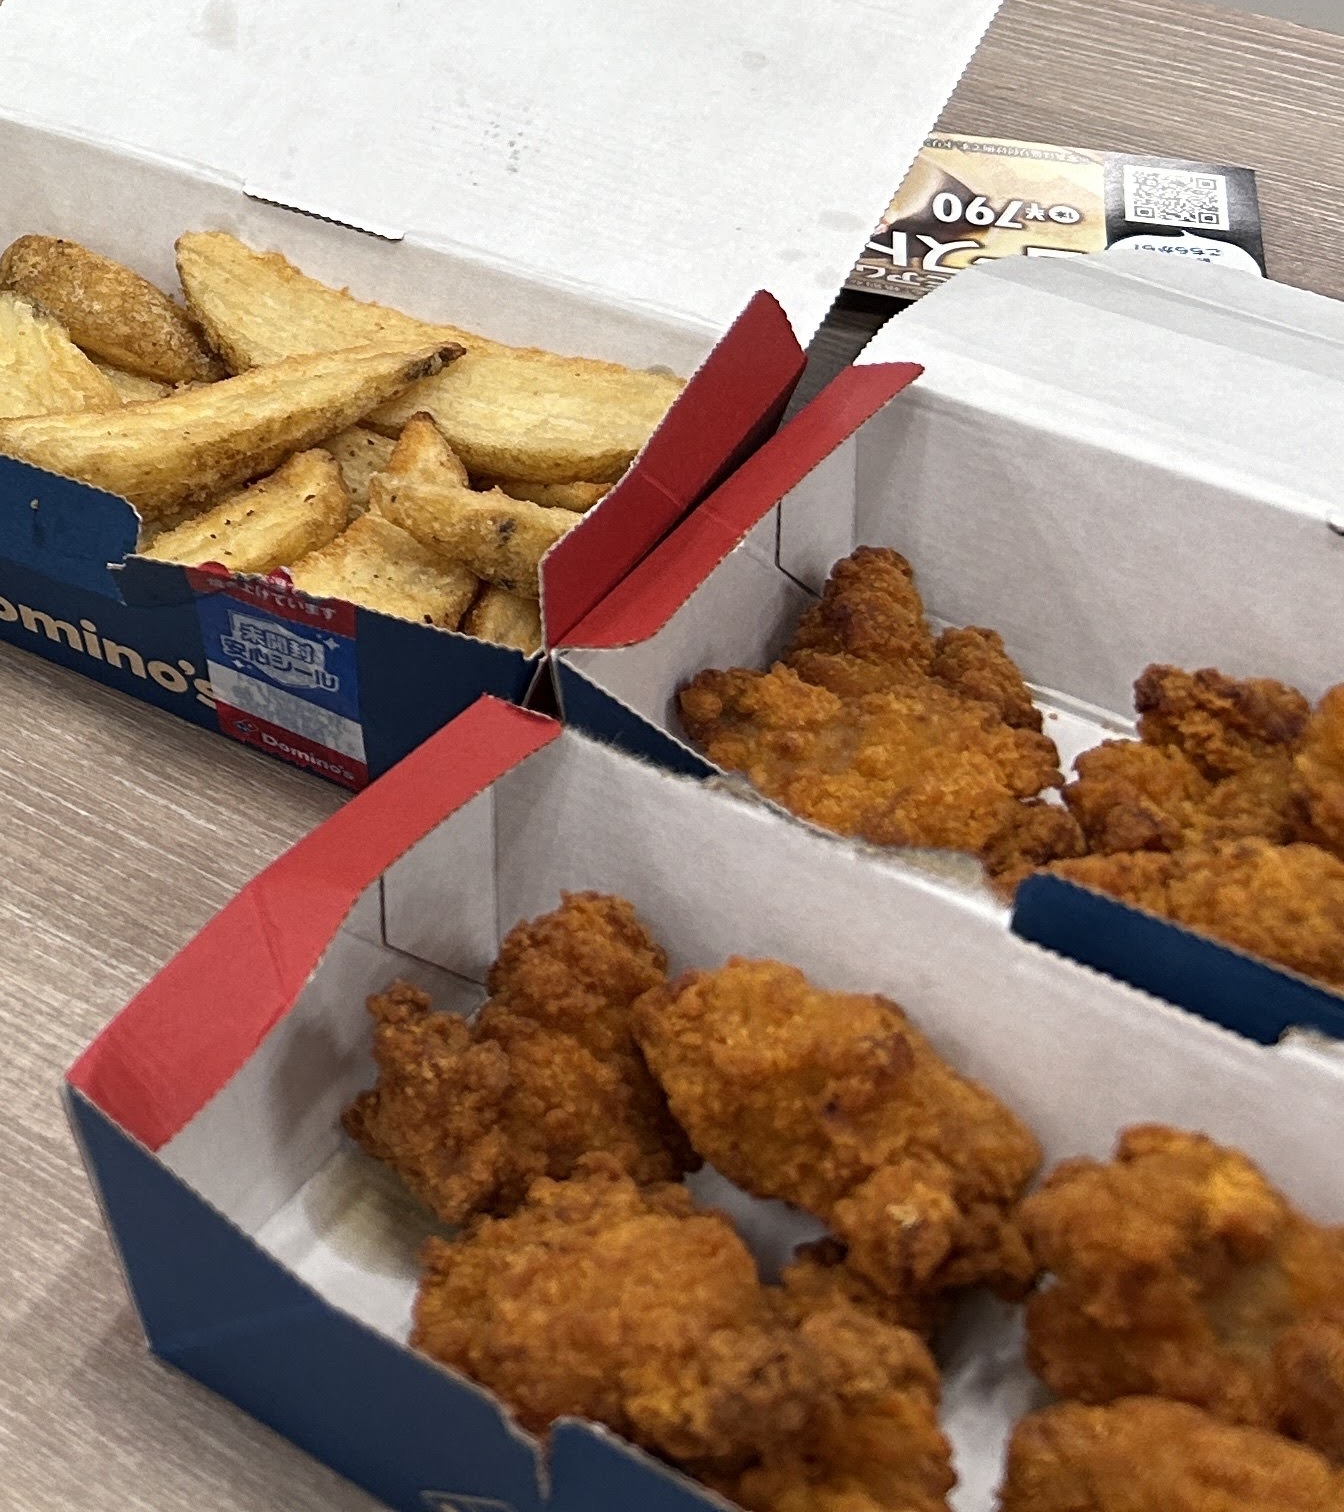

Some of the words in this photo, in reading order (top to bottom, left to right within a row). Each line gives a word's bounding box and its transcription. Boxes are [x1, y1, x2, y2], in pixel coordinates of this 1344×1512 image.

[223, 638, 338, 693] 安心シール
[239, 622, 321, 666] 未開封
[262, 731, 355, 781] Domino's
